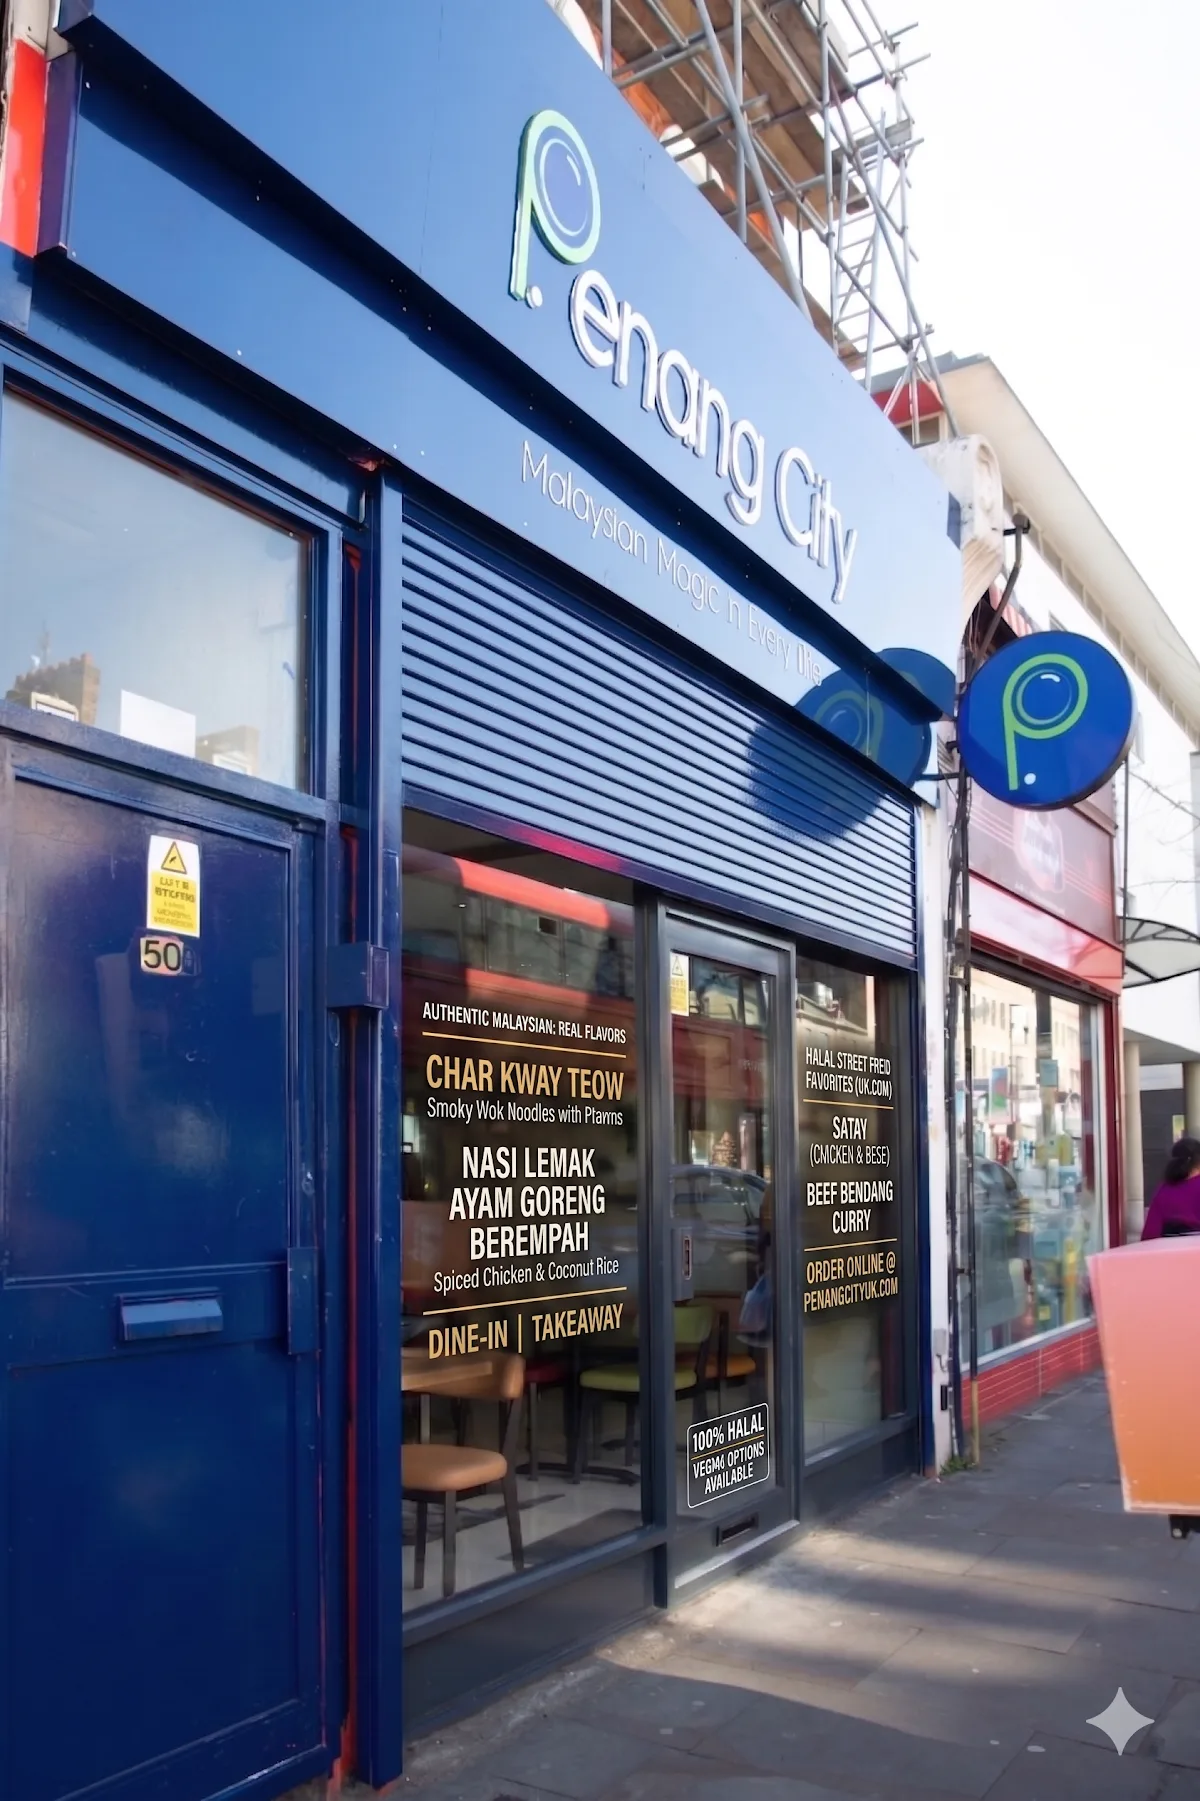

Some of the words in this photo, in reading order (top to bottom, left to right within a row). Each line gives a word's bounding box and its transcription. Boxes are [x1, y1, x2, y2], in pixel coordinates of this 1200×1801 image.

[774, 447, 858, 605] City
[521, 440, 648, 565] Malaysian
[657, 537, 720, 614] Magic
[747, 604, 791, 670] Every
[143, 939, 182, 972] 50
[422, 1001, 490, 1027] AUTHENTIC
[492, 1011, 556, 1035] MALAYSIAN:
[558, 1020, 583, 1039] REAL
[584, 1024, 627, 1044] FLAVORS
[805, 1046, 836, 1068] HALAL
[836, 1051, 868, 1073] STREET
[426, 1053, 494, 1093] CHAR
[500, 1060, 563, 1097] KWAY
[567, 1067, 625, 1101] TEOW
[805, 1070, 854, 1093] FAVORITES
[854, 1075, 893, 1101] (UK.COM)
[426, 1096, 473, 1124] Smoky
[475, 1100, 505, 1121] Wok
[507, 1102, 556, 1123] Noodles
[557, 1105, 582, 1124] with
[832, 1115, 868, 1140] SATAY
[462, 1146, 518, 1179] NASI
[524, 1147, 596, 1179] LEMAK
[856, 1145, 864, 1165] &
[865, 1145, 891, 1168] BESE)
[449, 1186, 514, 1221] AYAM
[520, 1184, 606, 1217] GORENG
[806, 1181, 838, 1207] BEEF
[840, 1179, 894, 1205] BENDANG
[832, 1208, 872, 1234] CURRY
[470, 1221, 590, 1261] BEREMPAH
[433, 1267, 480, 1297] Spiced
[483, 1262, 533, 1287] Chicken
[535, 1262, 545, 1282] &
[548, 1258, 595, 1281] Coconut
[596, 1256, 620, 1276] Rice
[806, 1257, 845, 1284] ORDER
[846, 1252, 884, 1278] ONLINE
[885, 1251, 896, 1275] @
[803, 1276, 899, 1313] PENANGCITYUK.COM
[428, 1319, 509, 1360] DINE-IN
[531, 1303, 625, 1343] TAKEAWAY
[692, 1424, 725, 1453] 100%
[727, 1412, 765, 1442] HALAL
[727, 1440, 765, 1467] OPTIONS
[704, 1461, 754, 1495] AVAILABLE
